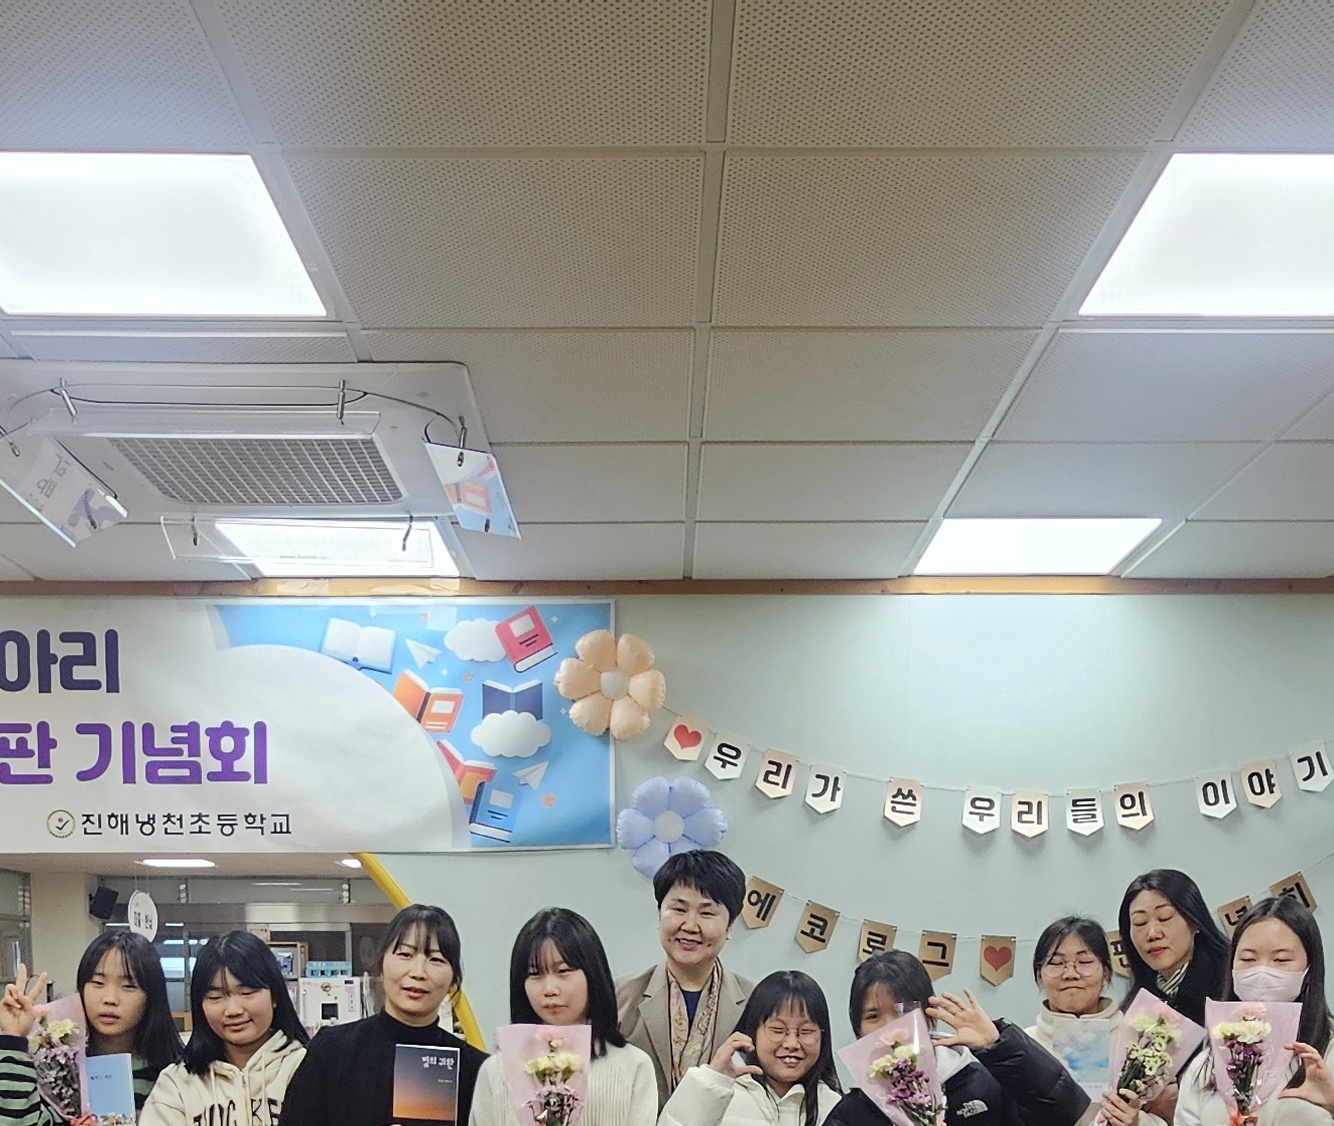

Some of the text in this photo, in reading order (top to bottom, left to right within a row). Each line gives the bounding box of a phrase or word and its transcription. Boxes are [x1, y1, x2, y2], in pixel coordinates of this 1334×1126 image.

[75, 720, 268, 785] 기념회
[713, 742, 1330, 826] 우리가 쓴 우리들의 이야기
[81, 811, 293, 838] 진해냉천초등학교
